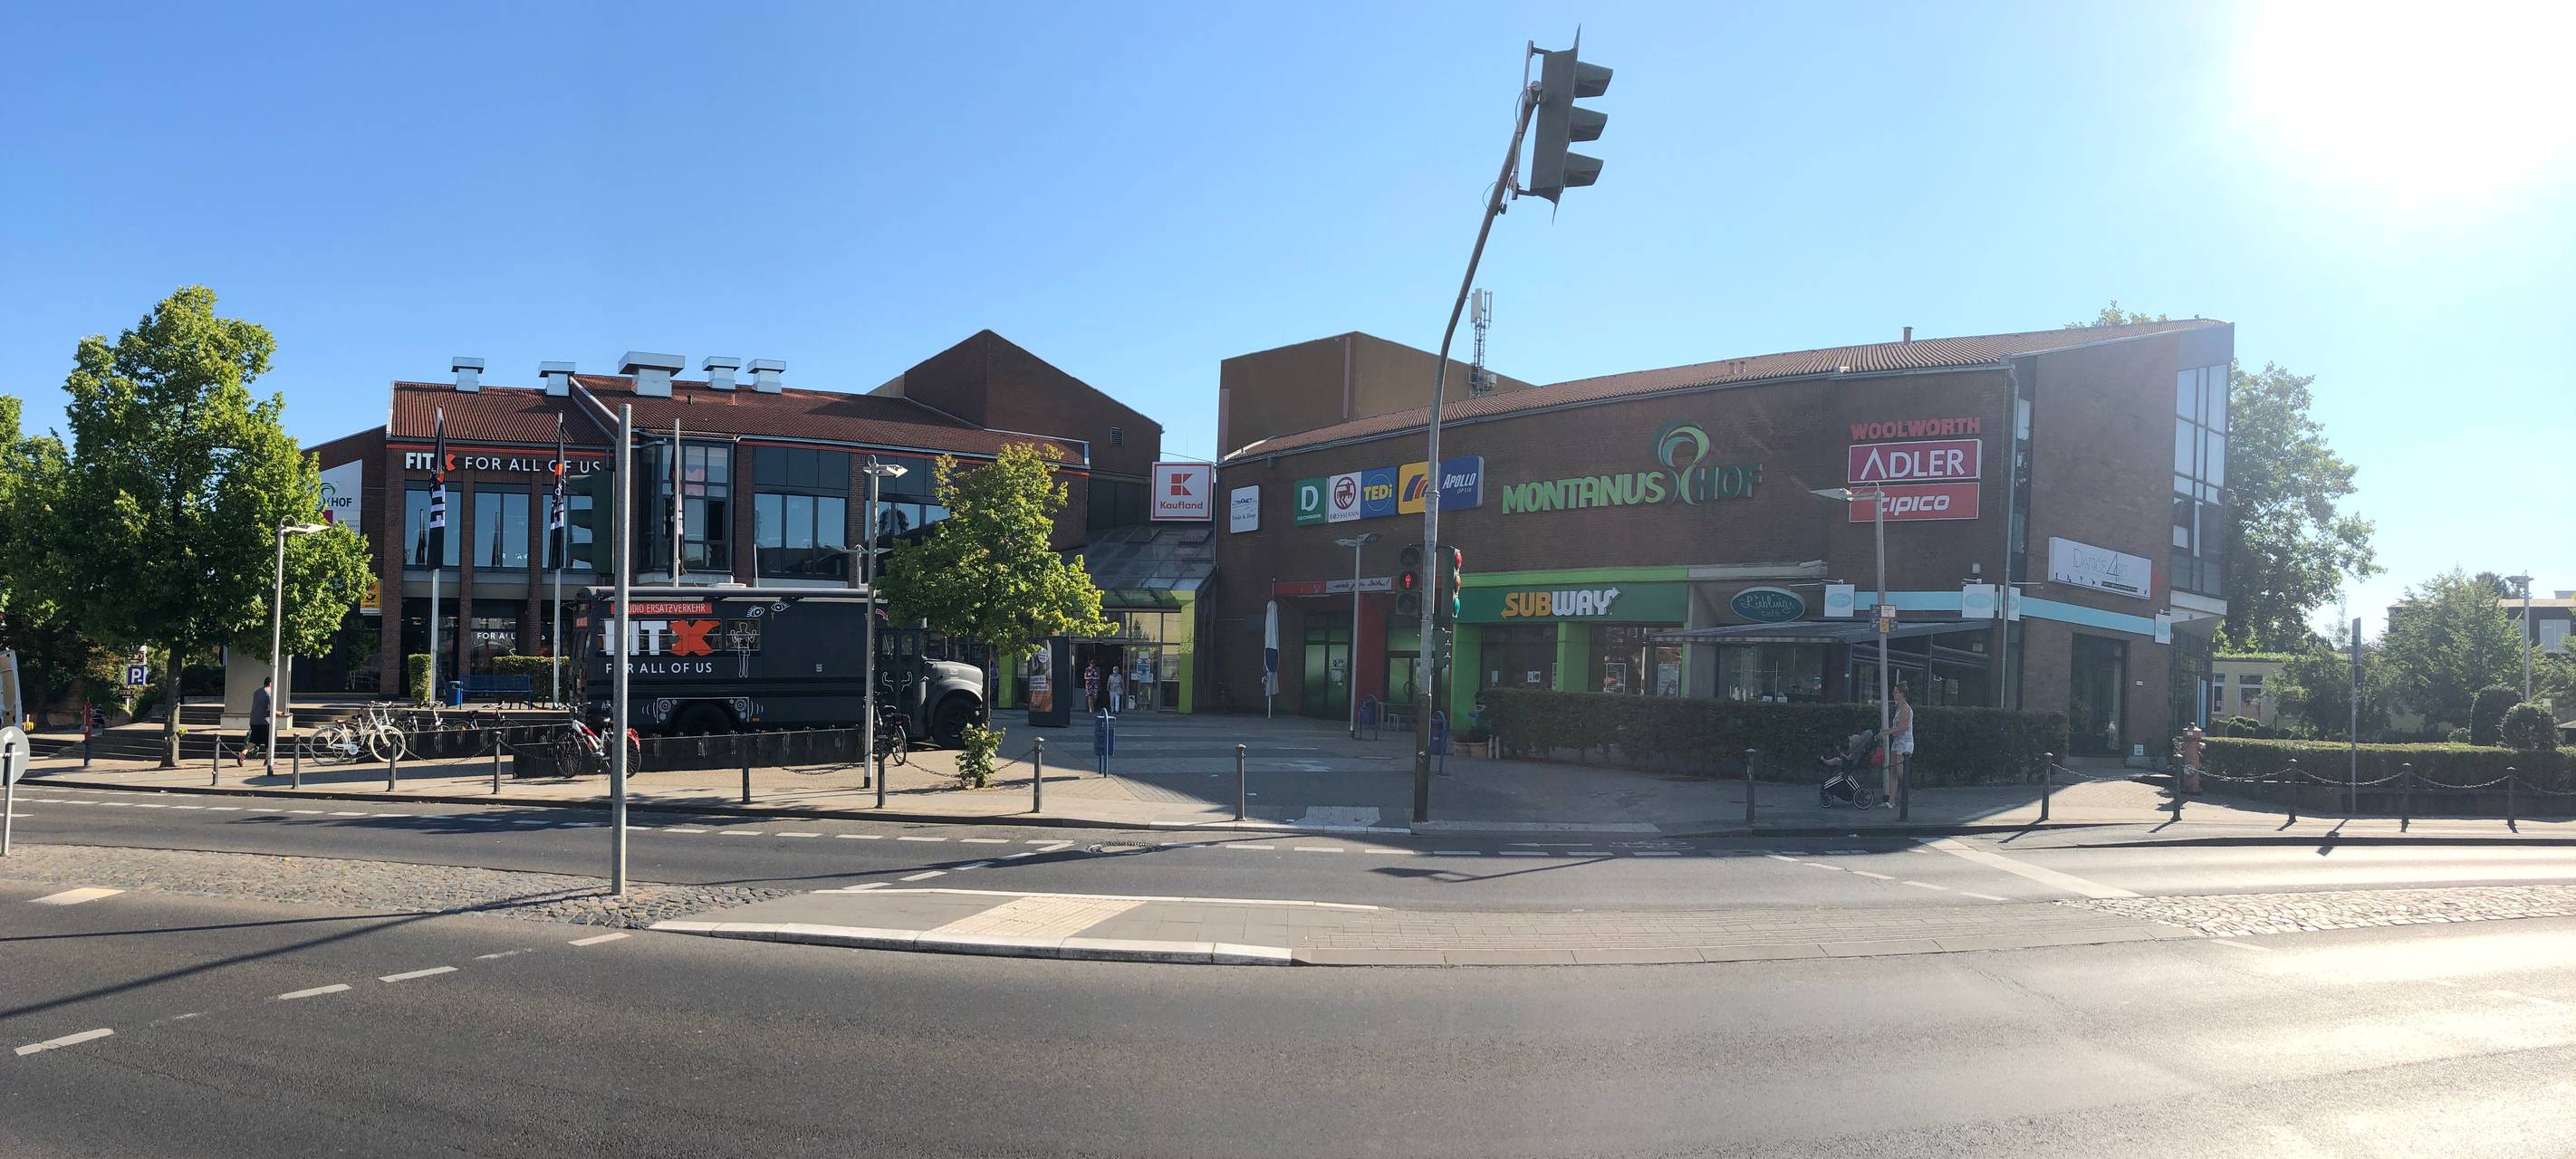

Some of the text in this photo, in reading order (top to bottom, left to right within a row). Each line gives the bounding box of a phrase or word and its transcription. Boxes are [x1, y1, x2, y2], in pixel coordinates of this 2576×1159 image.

[1850, 417, 1981, 440] WOOLWORTH
[465, 456, 501, 470] FOR
[509, 459, 541, 472] ALL
[1860, 446, 1966, 480] ADLER
[1442, 472, 1477, 490] APOLLO
[1502, 463, 1764, 514] MONTANUS HOF
[1363, 484, 1393, 502] TEDi
[332, 497, 352, 507] HOF
[1159, 501, 1204, 510] Kaufland
[647, 602, 706, 613] ERSATZVERKEHR
[1500, 587, 1622, 619] SUBWAY
[476, 632, 495, 640] FOR
[130, 668, 142, 684] P
[605, 662, 713, 674] FR ALL OF US
